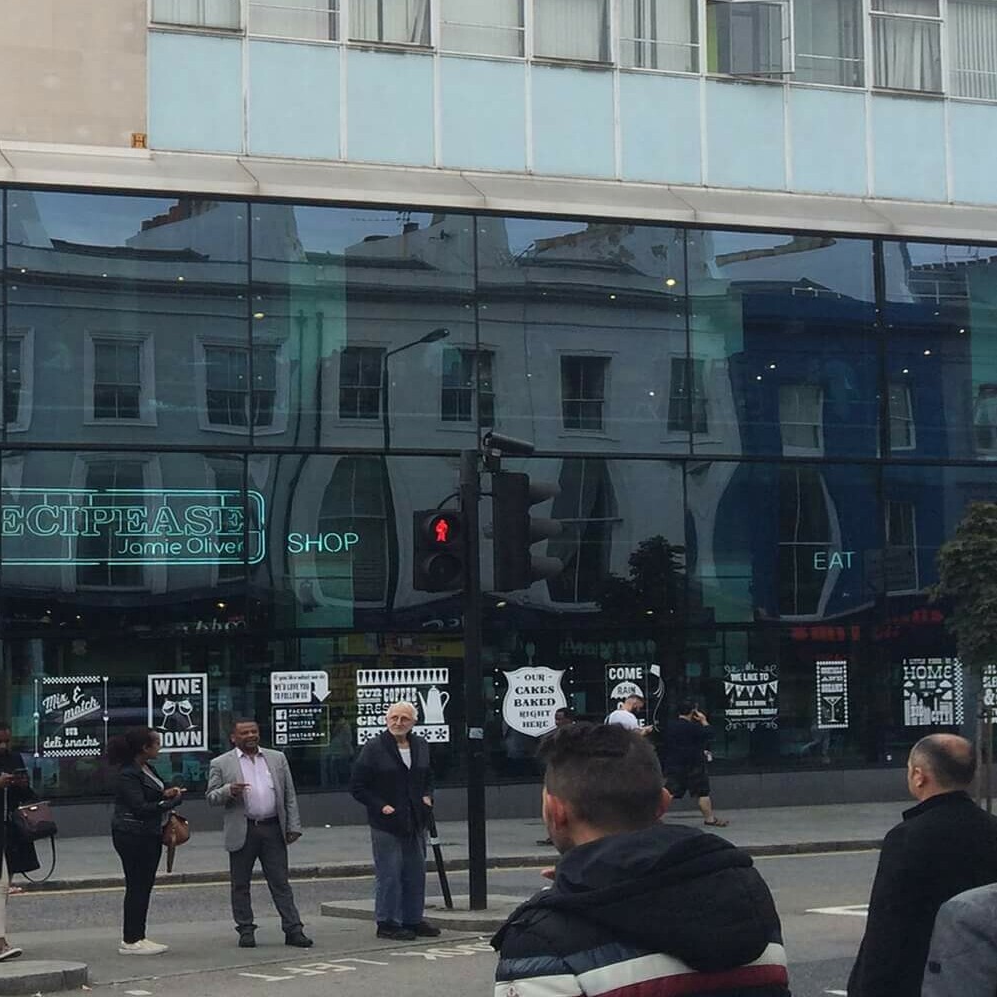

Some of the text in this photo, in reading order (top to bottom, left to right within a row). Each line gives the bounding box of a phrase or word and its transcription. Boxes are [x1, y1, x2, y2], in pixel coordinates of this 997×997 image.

[117, 537, 244, 555] Jamie Oliver
[287, 532, 360, 555] SHOP
[813, 551, 857, 571] EAT
[524, 674, 546, 682] OUR
[608, 667, 643, 681] COME
[903, 665, 953, 680] HOME
[154, 678, 202, 695] WINE
[515, 685, 555, 695] CAKES
[617, 686, 637, 694] RAIN
[356, 687, 418, 703] OUR COFFEE
[42, 693, 70, 714] Mix
[514, 698, 556, 707] BAKED
[63, 696, 101, 724] match
[519, 710, 551, 718] RIGHT
[522, 720, 549, 728] HERE
[43, 734, 101, 748] deli snacks
